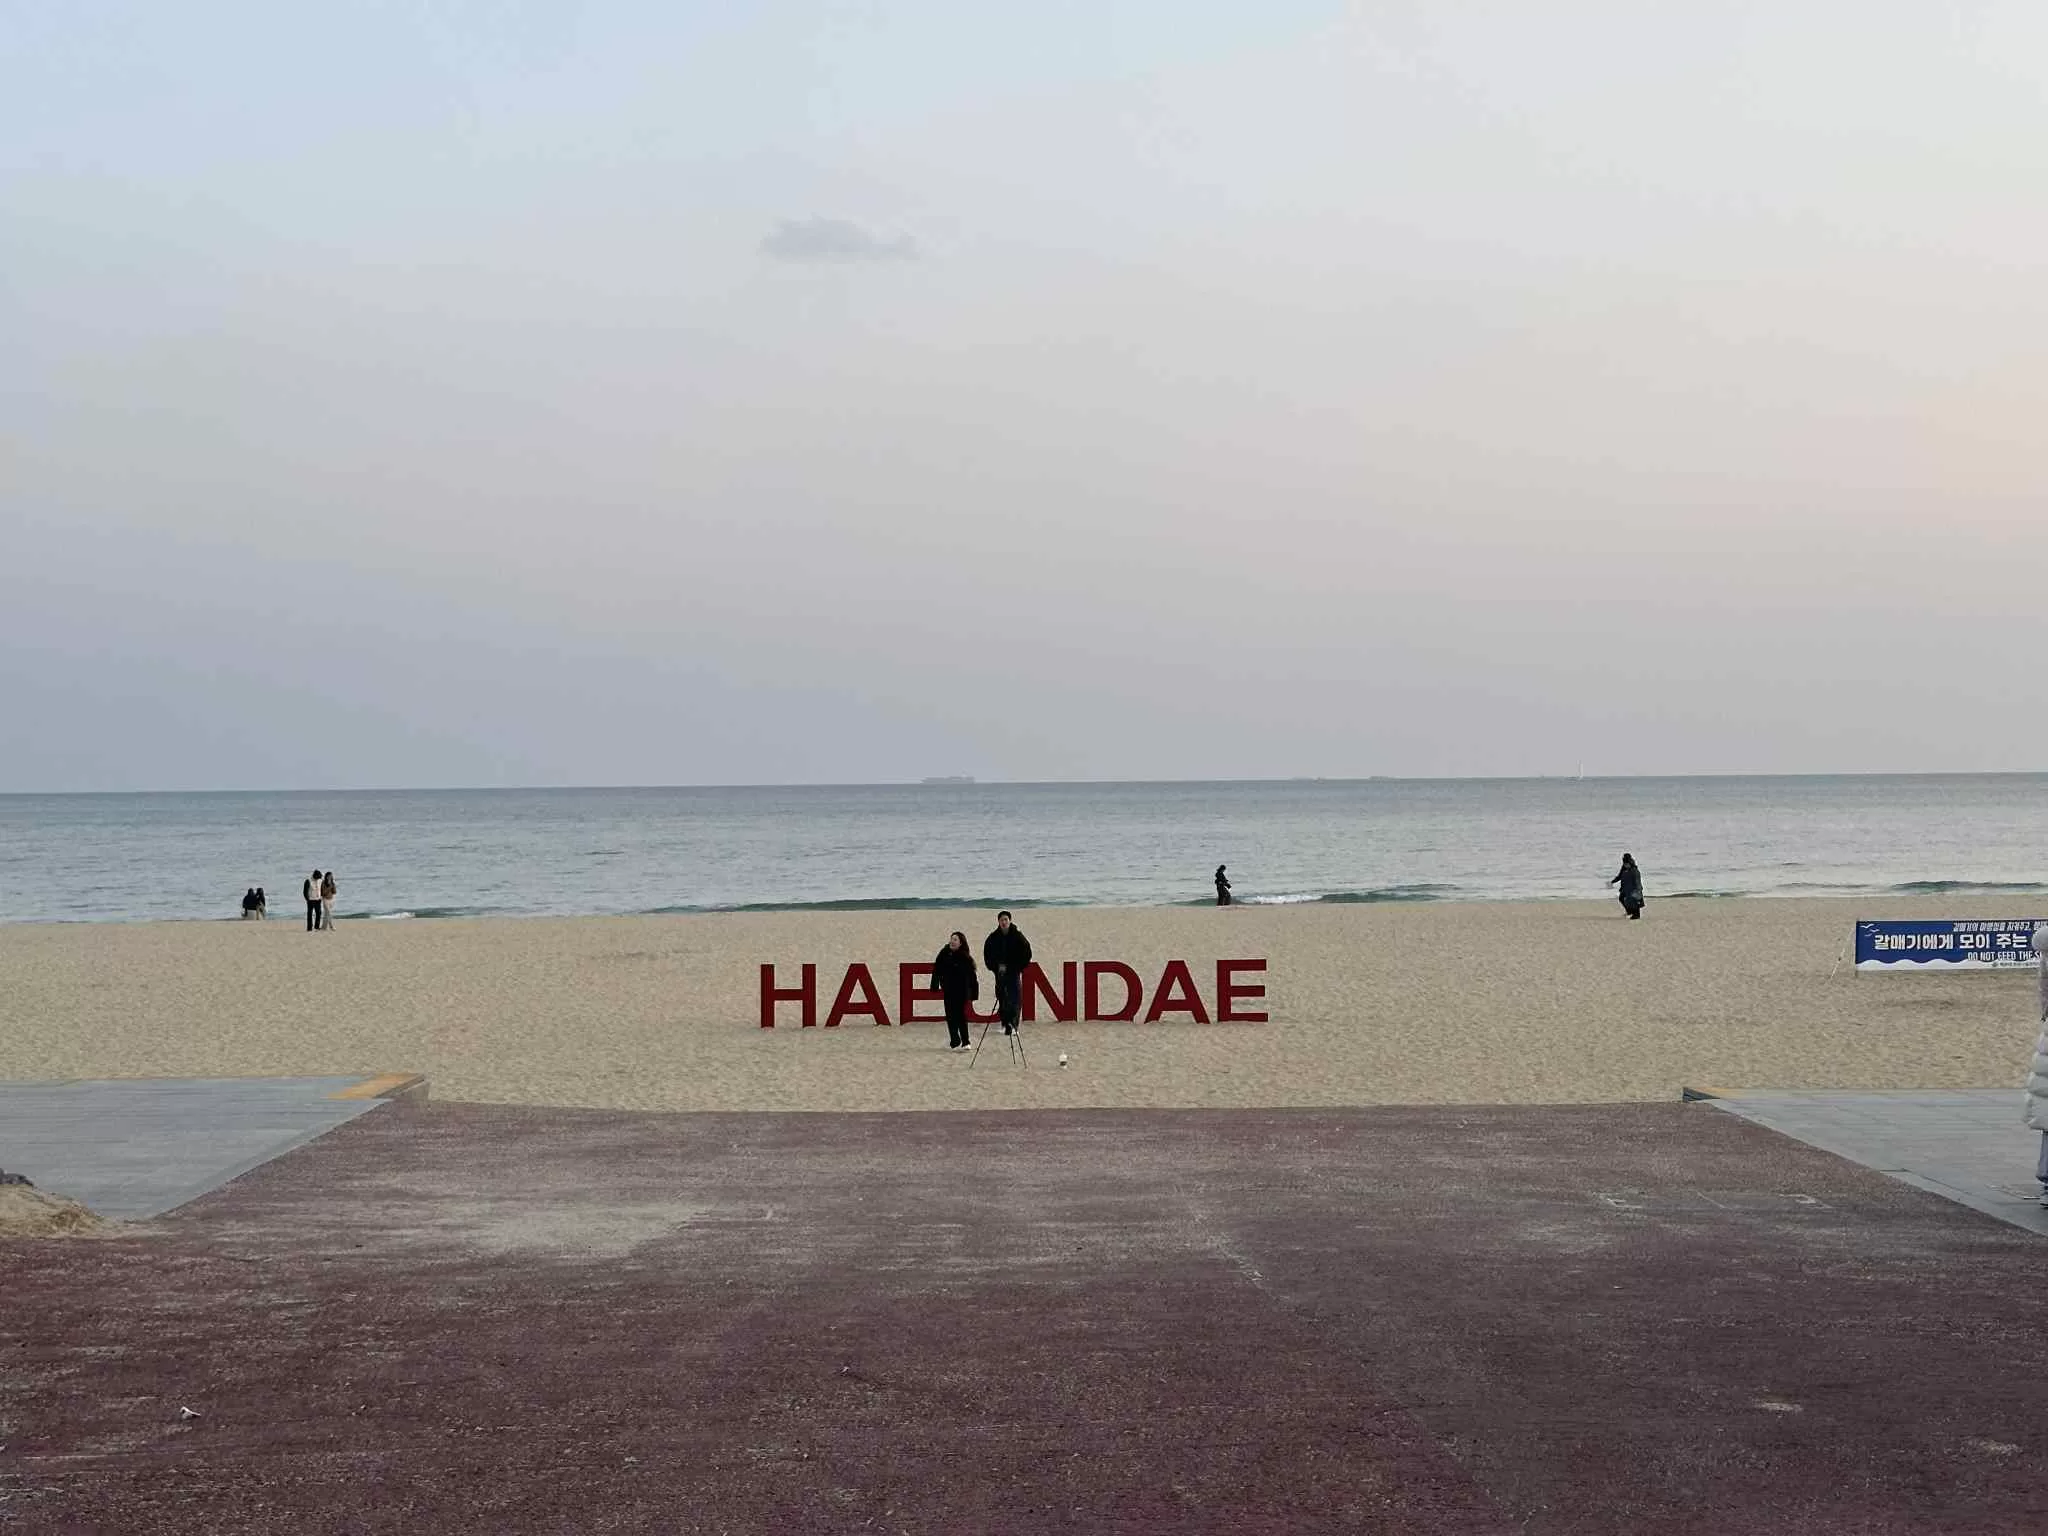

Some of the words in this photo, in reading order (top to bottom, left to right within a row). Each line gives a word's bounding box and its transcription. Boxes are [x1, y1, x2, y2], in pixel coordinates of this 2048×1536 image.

[1874, 933, 1954, 950] 갈매기에게
[1959, 933, 1990, 949] 모이
[1996, 933, 2028, 949] 주는
[1967, 951, 1978, 961] DO
[1980, 951, 1995, 961] NOT
[1997, 951, 2016, 961] FEED
[2018, 950, 2033, 960] THE
